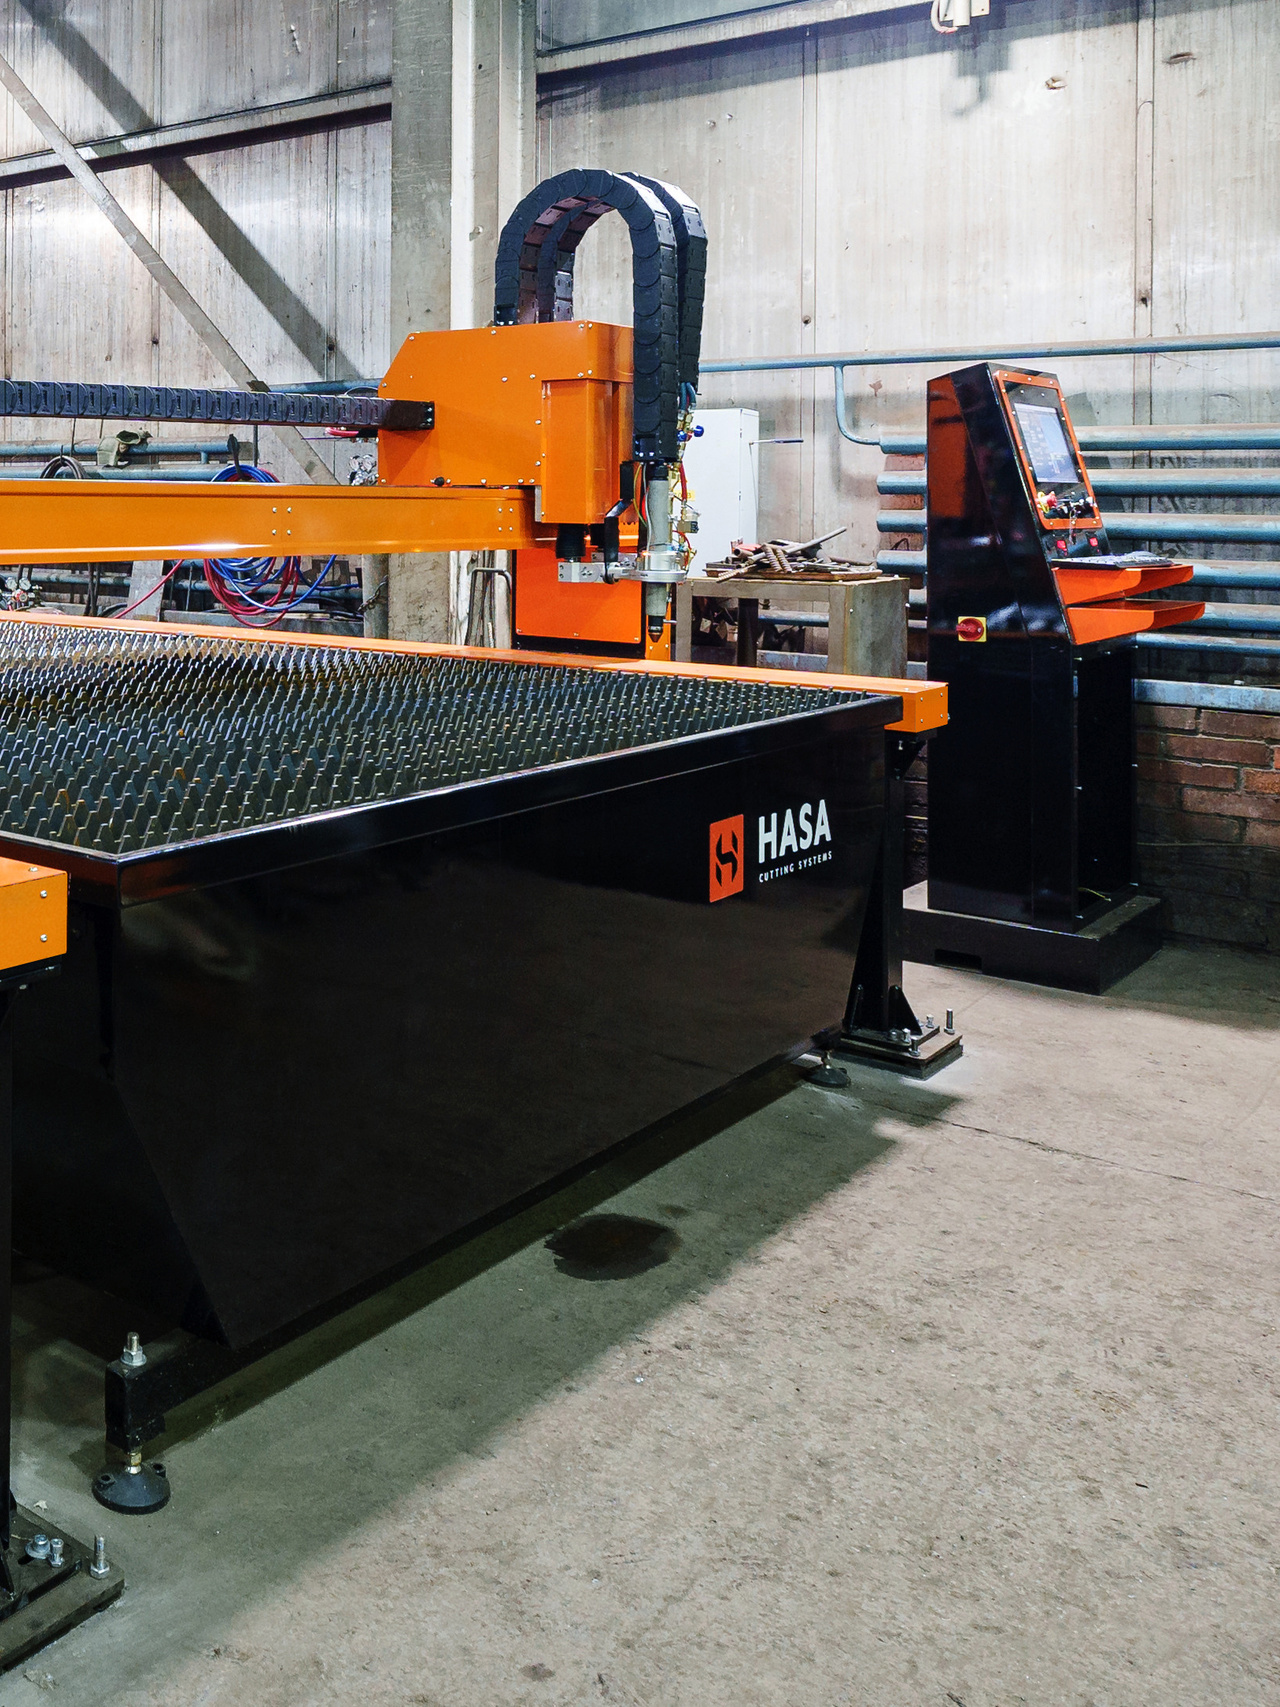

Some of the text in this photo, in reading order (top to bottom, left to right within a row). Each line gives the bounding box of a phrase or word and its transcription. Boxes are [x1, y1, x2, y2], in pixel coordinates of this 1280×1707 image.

[758, 799, 832, 863] HASA
[759, 850, 833, 883] CUTTING SYSTEMS
